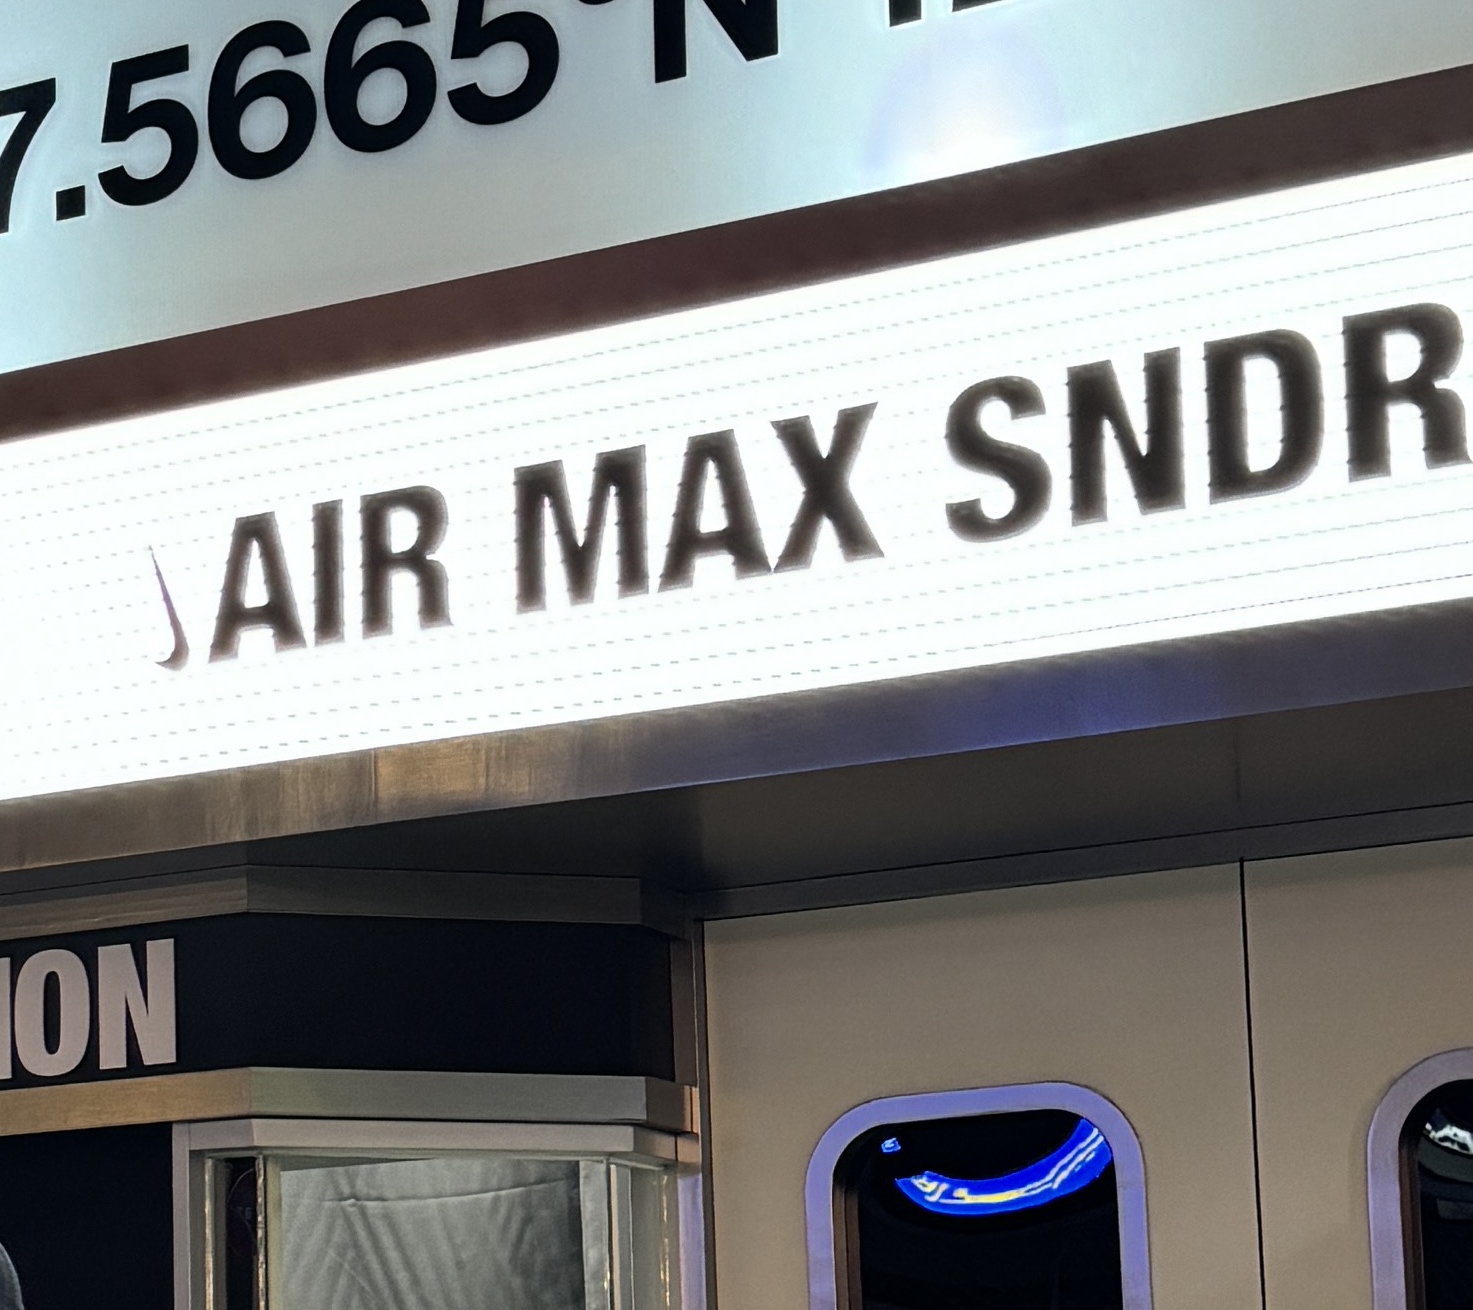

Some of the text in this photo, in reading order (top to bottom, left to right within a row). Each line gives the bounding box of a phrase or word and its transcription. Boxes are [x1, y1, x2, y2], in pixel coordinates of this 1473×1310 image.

[209, 303, 1472, 658] AIR MAX SNDR
